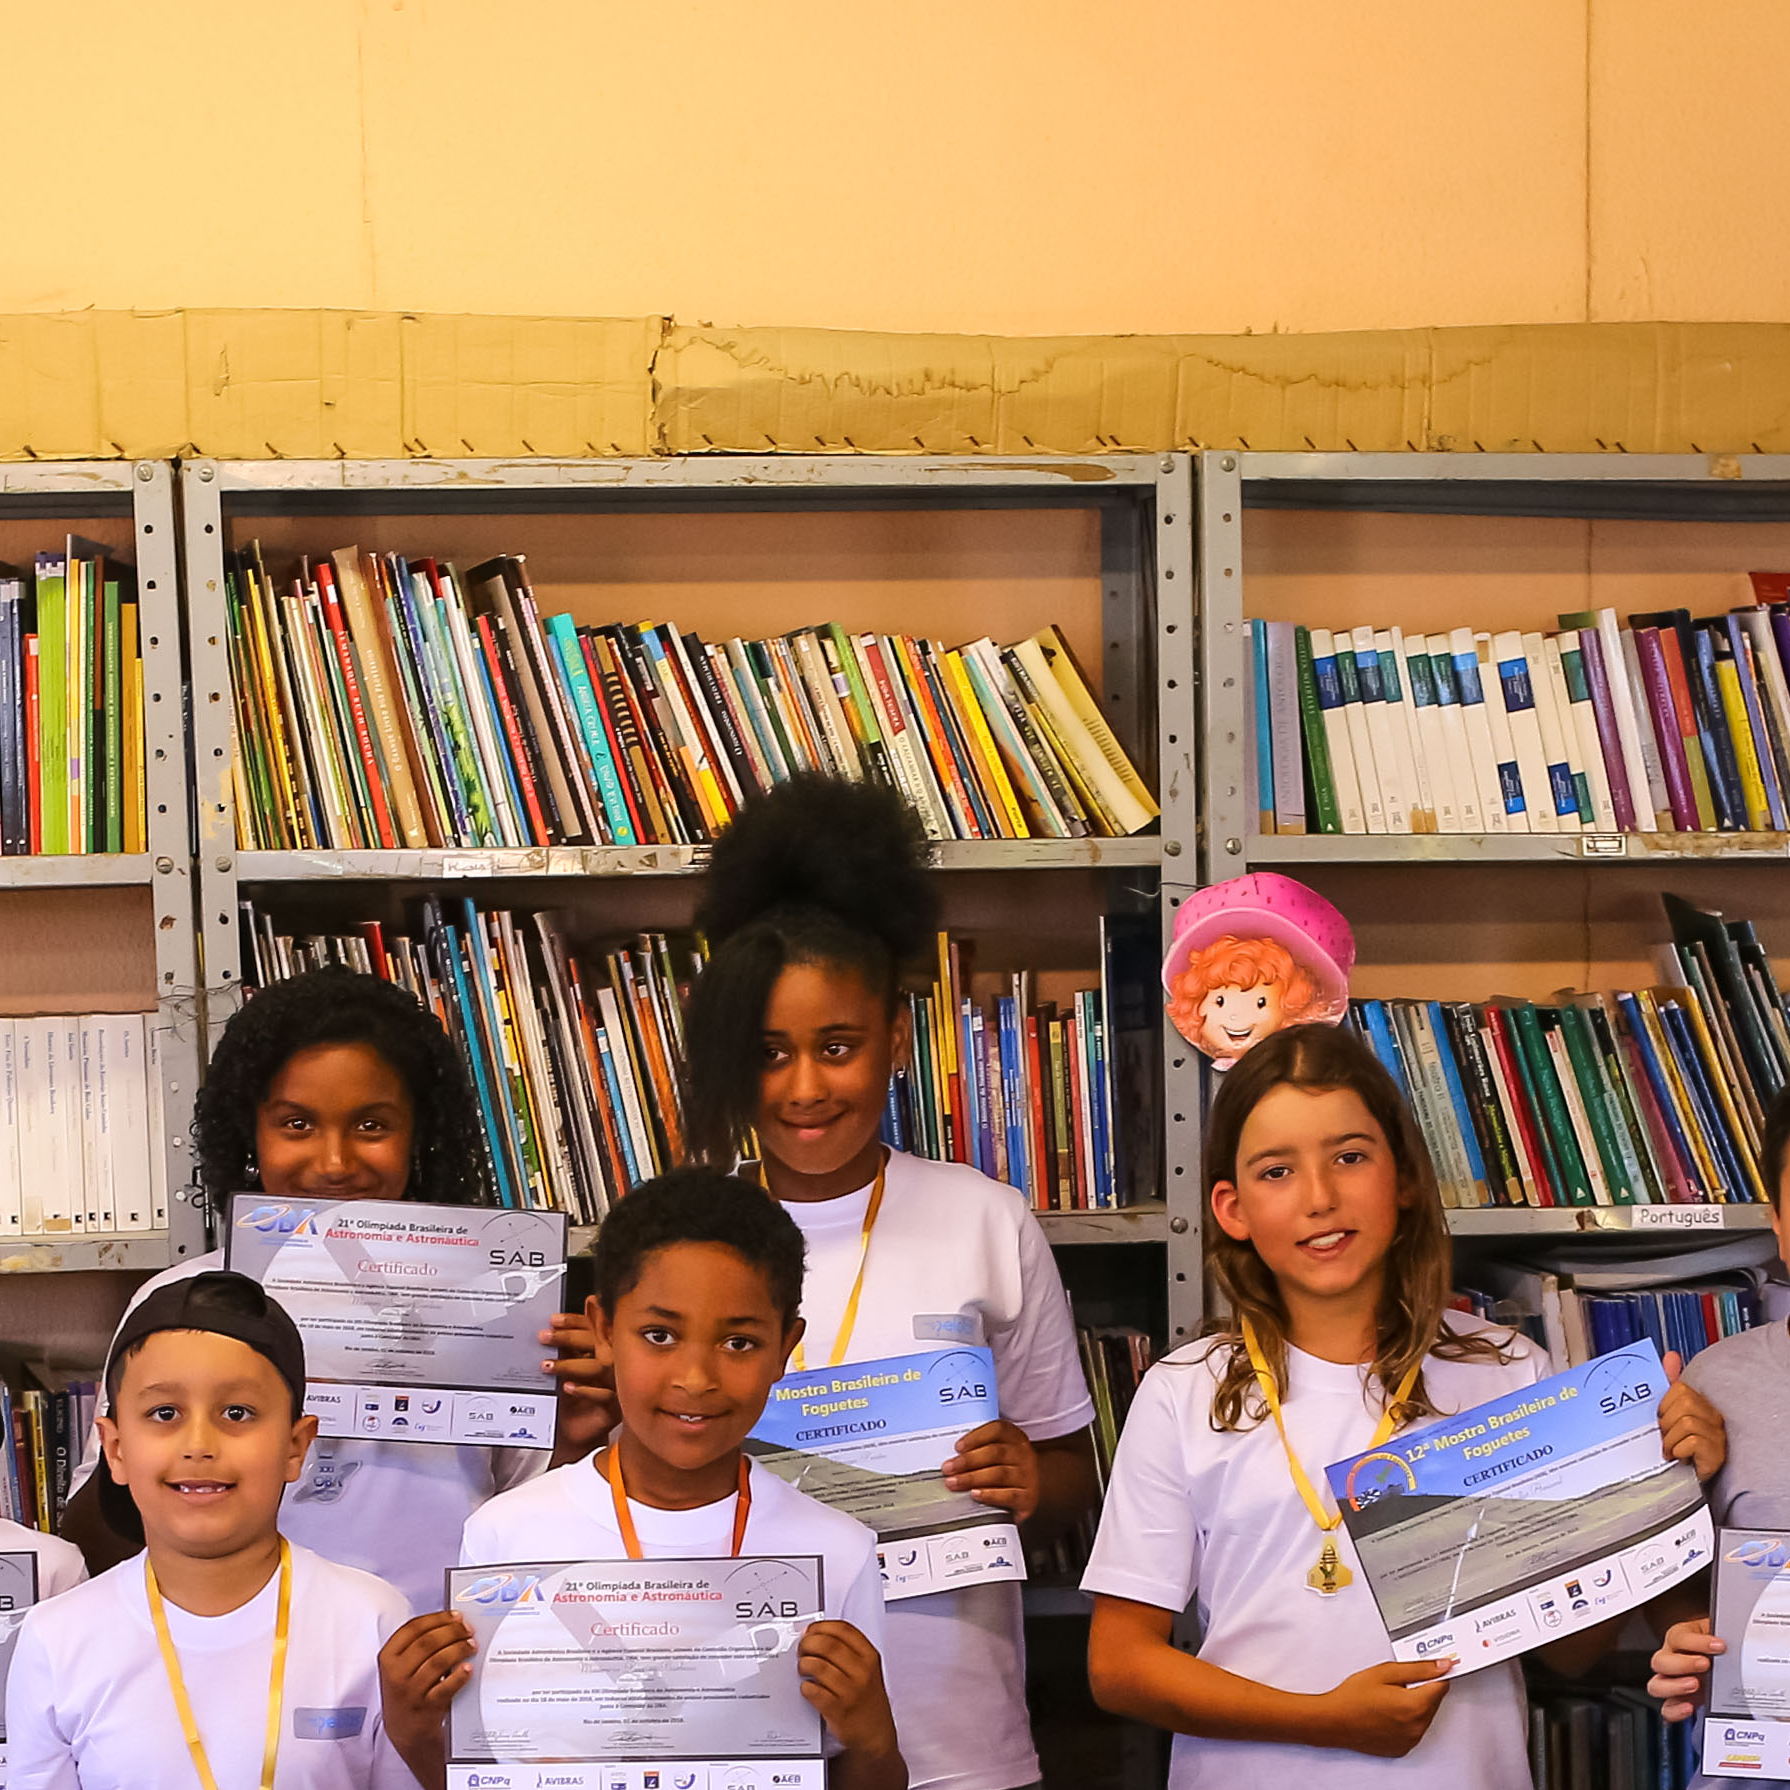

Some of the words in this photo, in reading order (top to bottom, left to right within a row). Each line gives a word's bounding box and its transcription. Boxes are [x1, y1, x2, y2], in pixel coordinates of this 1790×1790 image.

[338, 630, 361, 692] ALMANAQUE
[353, 696, 365, 725] RUTH
[359, 728, 373, 766] ROCHA
[1640, 1207, 1720, 1227] Português
[326, 1228, 393, 1242] Astronomia
[406, 1231, 479, 1247] Astronáutica
[357, 1220, 407, 1232] Olimpíada
[409, 1223, 454, 1234] Brasileira
[457, 1226, 468, 1235] de
[358, 1259, 438, 1277] Certificado
[489, 1250, 545, 1267] SAB
[776, 1382, 828, 1402] Mostra
[831, 1374, 899, 1394] Brasileira
[903, 1368, 921, 1382] de
[939, 1383, 987, 1403] SAB
[802, 1396, 869, 1418] Foguetes
[1599, 1383, 1652, 1415] SAB
[1433, 1422, 1486, 1452] Mostra
[1488, 1396, 1556, 1429] Brasileira
[1559, 1386, 1578, 1401] de
[796, 1419, 887, 1442] CERTIFICADO
[1463, 1426, 1531, 1461] Foguetes
[1463, 1443, 1554, 1488] CERTIFICADO
[553, 1591, 628, 1603] Astronomia
[642, 1587, 723, 1602] Astronáutica
[586, 1580, 641, 1593] Olimpíada
[644, 1580, 692, 1591] Brasileira
[736, 1600, 798, 1619] SAB
[591, 1621, 680, 1638] Certificado
